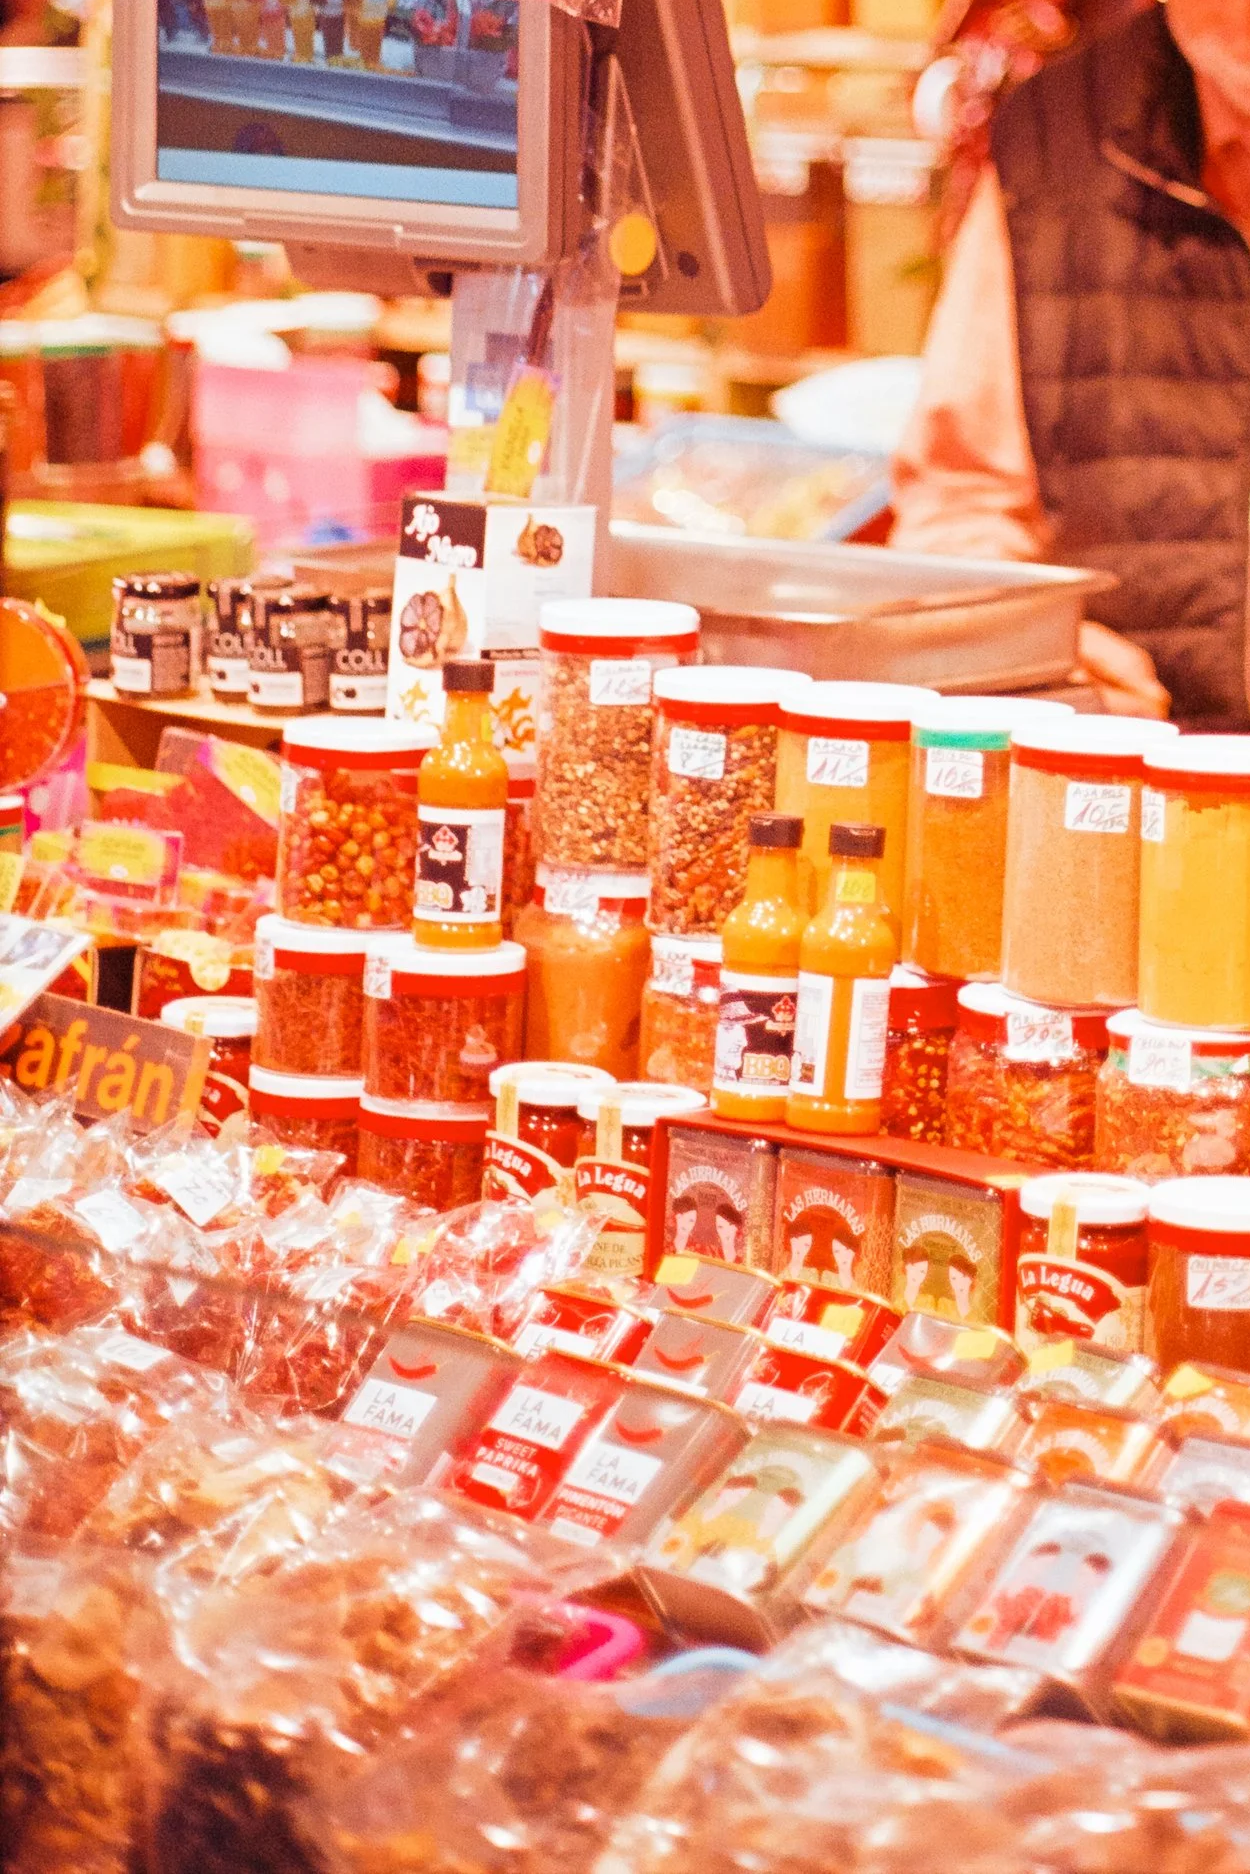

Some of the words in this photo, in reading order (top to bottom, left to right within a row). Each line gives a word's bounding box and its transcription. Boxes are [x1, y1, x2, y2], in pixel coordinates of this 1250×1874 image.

[743, 1053, 791, 1081] BBQ
[594, 1164, 647, 1200] Legua
[803, 1185, 865, 1237] HERMANAS
[1040, 1265, 1095, 1302] Legua
[781, 1327, 805, 1345] LA
[373, 1388, 395, 1405] LA
[520, 1395, 543, 1413] LA
[752, 1392, 775, 1412] LA
[363, 1406, 415, 1433] FAMA
[510, 1413, 562, 1443] FAMA
[495, 1436, 537, 1457] SWEET
[476, 1450, 539, 1477] PAPRIKA
[596, 1452, 620, 1470] LA
[588, 1468, 638, 1496] FAMA
